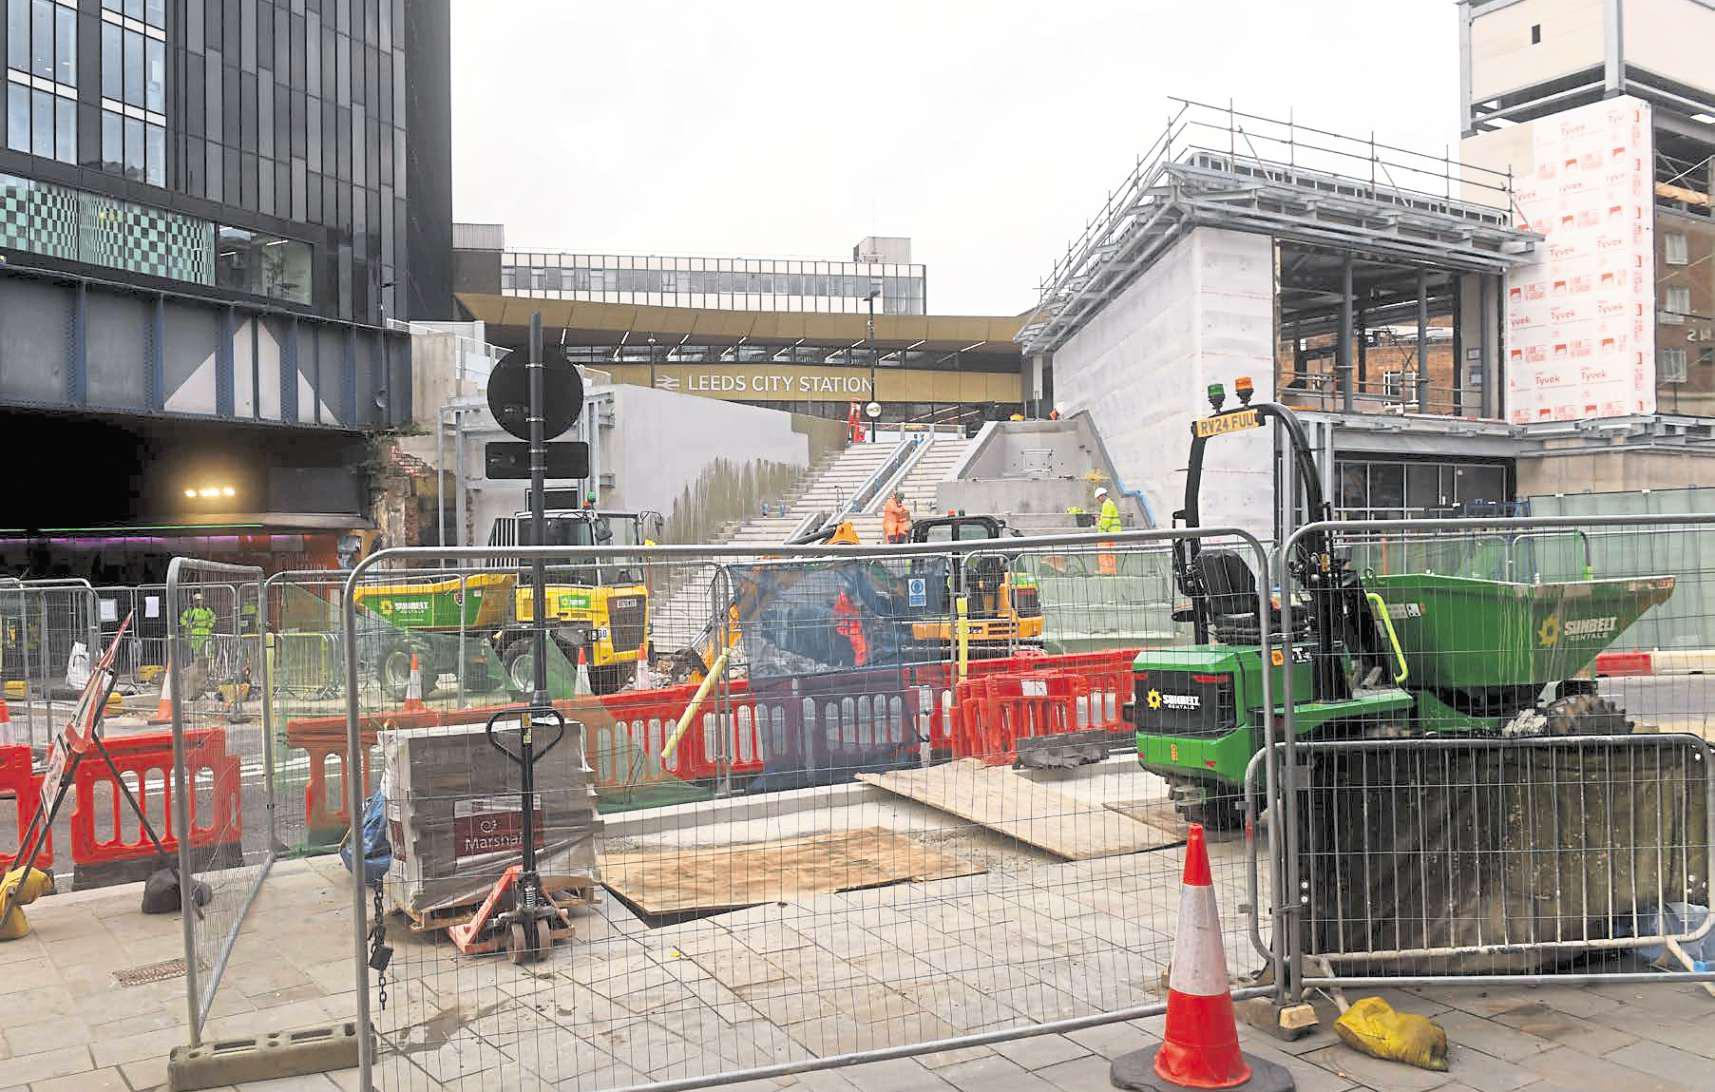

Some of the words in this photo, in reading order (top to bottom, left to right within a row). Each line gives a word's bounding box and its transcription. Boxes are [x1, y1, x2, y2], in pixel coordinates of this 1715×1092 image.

[687, 375, 747, 391] LEEDS
[752, 376, 793, 392] CITY
[799, 376, 873, 393] STATION
[1536, 374, 1561, 386] Tyvek
[1201, 418, 1229, 435] RY24
[1565, 616, 1617, 636] SUNBELT
[1162, 694, 1200, 706] SUNBELT
[465, 832, 523, 851] Marshal
